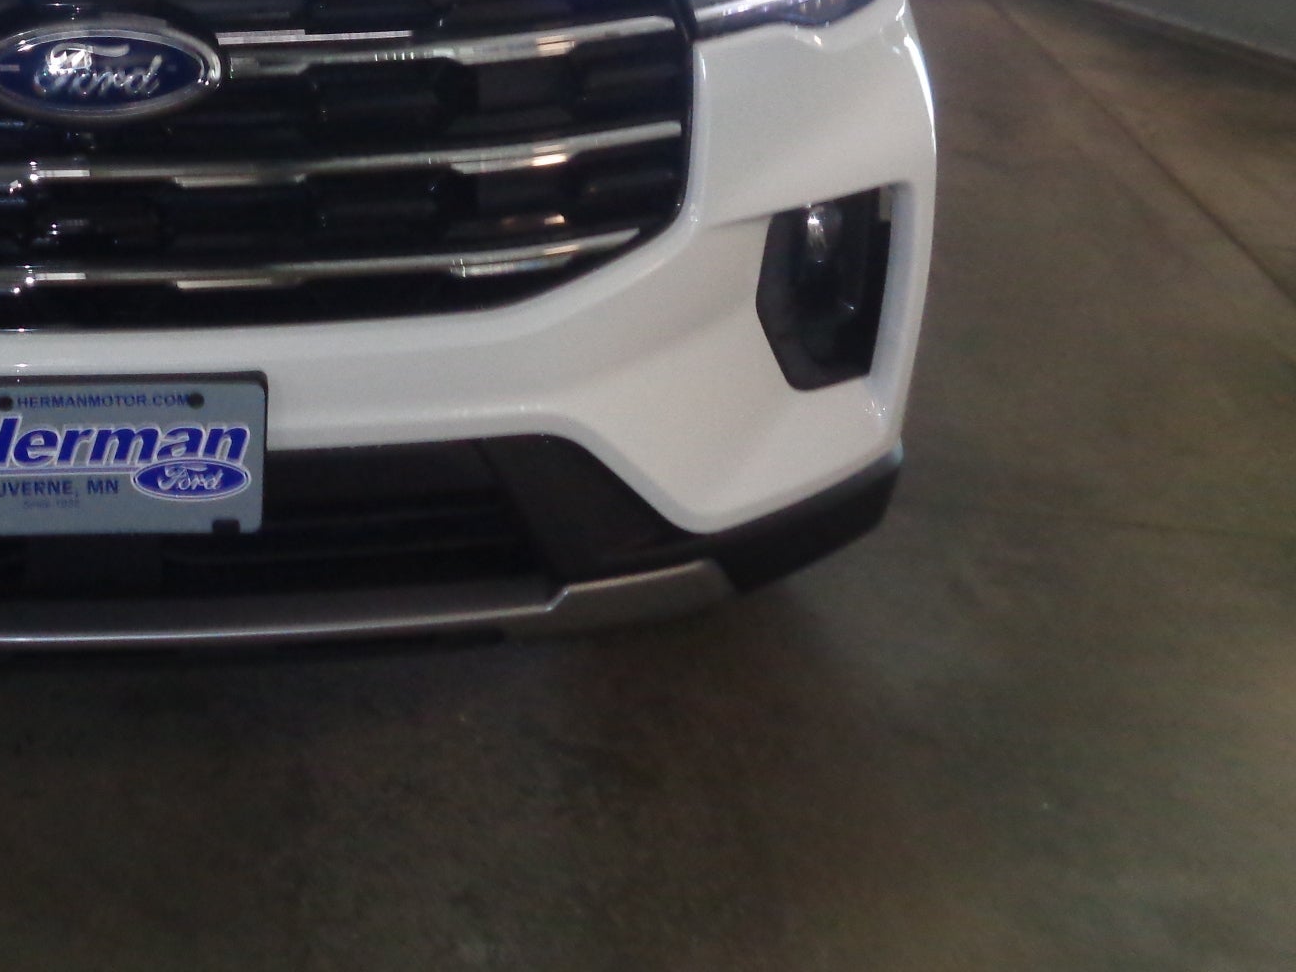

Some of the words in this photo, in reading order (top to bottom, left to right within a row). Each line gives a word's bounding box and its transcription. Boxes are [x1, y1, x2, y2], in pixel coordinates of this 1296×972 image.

[33, 42, 164, 96] Ford
[16, 394, 190, 409] HERMANMOTOR.COM
[87, 478, 120, 495] MN
[157, 462, 224, 491] Ford
